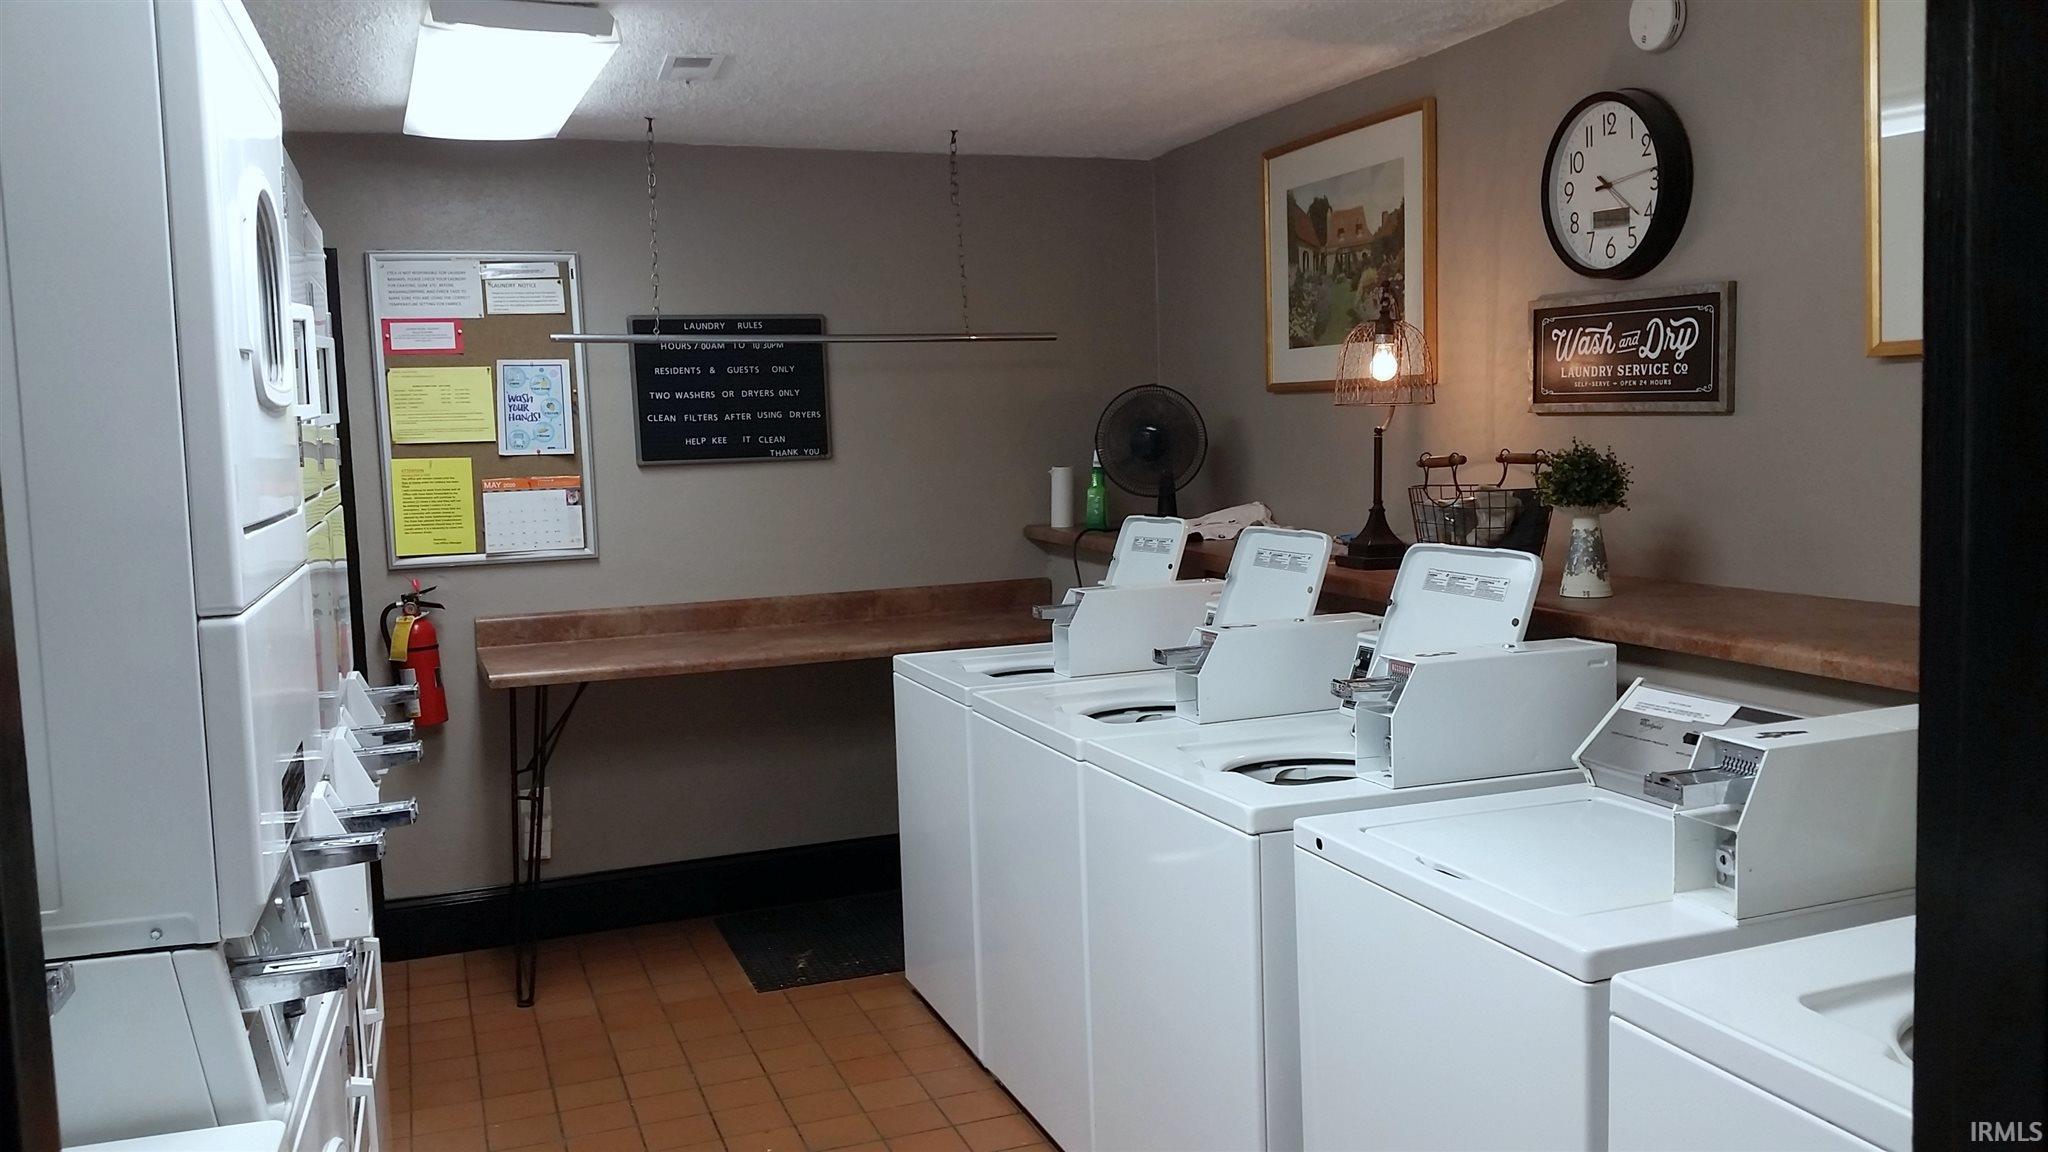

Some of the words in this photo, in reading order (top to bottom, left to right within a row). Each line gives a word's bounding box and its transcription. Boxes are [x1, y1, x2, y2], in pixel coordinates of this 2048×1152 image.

[1603, 112, 1617, 136] 12
[1630, 117, 1634, 140] 1
[1586, 126, 1593, 148] 11
[1642, 133, 1652, 157] 2
[1570, 151, 1584, 174] 10
[1650, 166, 1658, 190] 3
[1564, 182, 1574, 204] 9
[1644, 200, 1654, 218] 4
[1570, 212, 1579, 234] 8
[1586, 232, 1595, 254] 7
[1606, 236, 1616, 259] 6
[1628, 226, 1637, 249] 5
[1552, 322, 1616, 362] Wash
[1618, 331, 1641, 348] and
[1638, 317, 1700, 360] Dry
[654, 367, 701, 375] RESIDENTS
[1561, 366, 1613, 378] LAUNDRY
[1617, 363, 1669, 376] SERVICE
[675, 391, 716, 399] WASHERS
[685, 437, 706, 445] HELP
